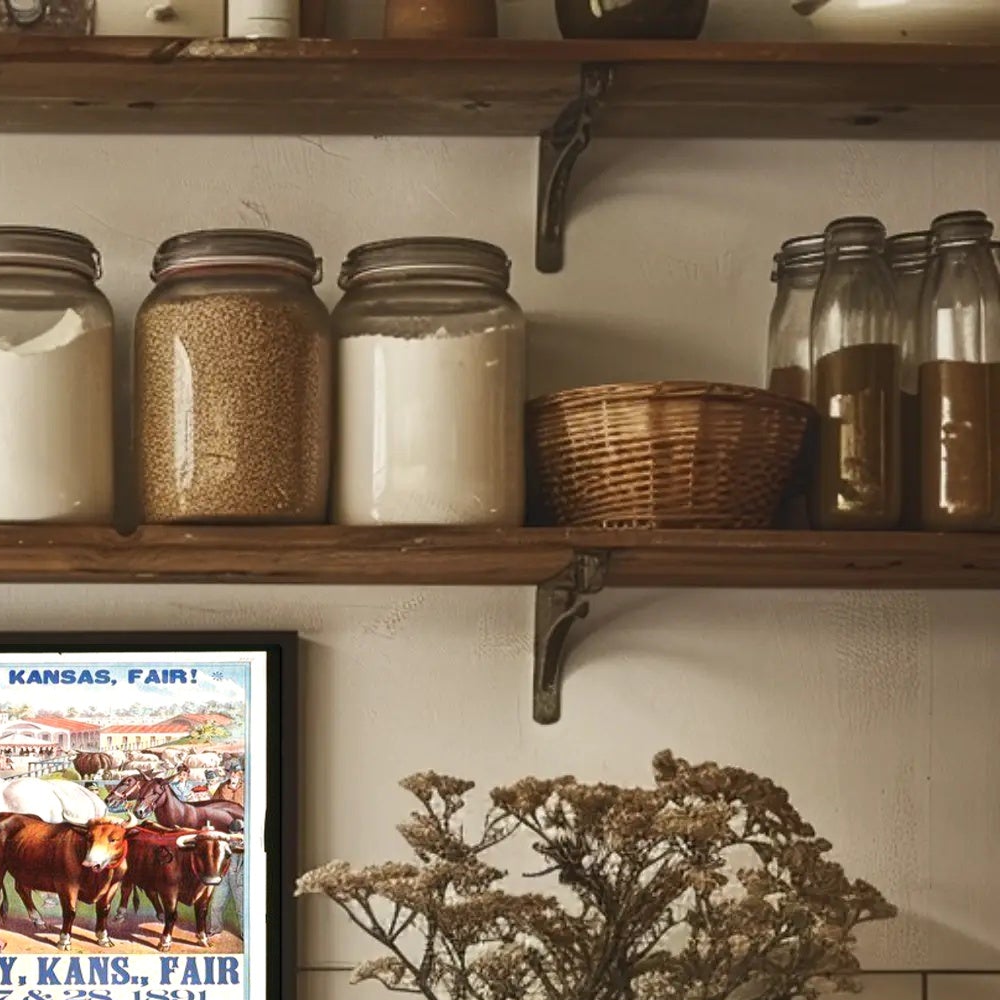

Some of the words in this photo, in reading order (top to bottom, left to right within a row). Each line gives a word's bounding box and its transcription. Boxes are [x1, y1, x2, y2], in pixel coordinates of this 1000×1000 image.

[9, 670, 118, 686] KANSAS,
[128, 669, 198, 685] FAIR!
[37, 957, 149, 986] KANS.,
[159, 957, 240, 985] FAIR
